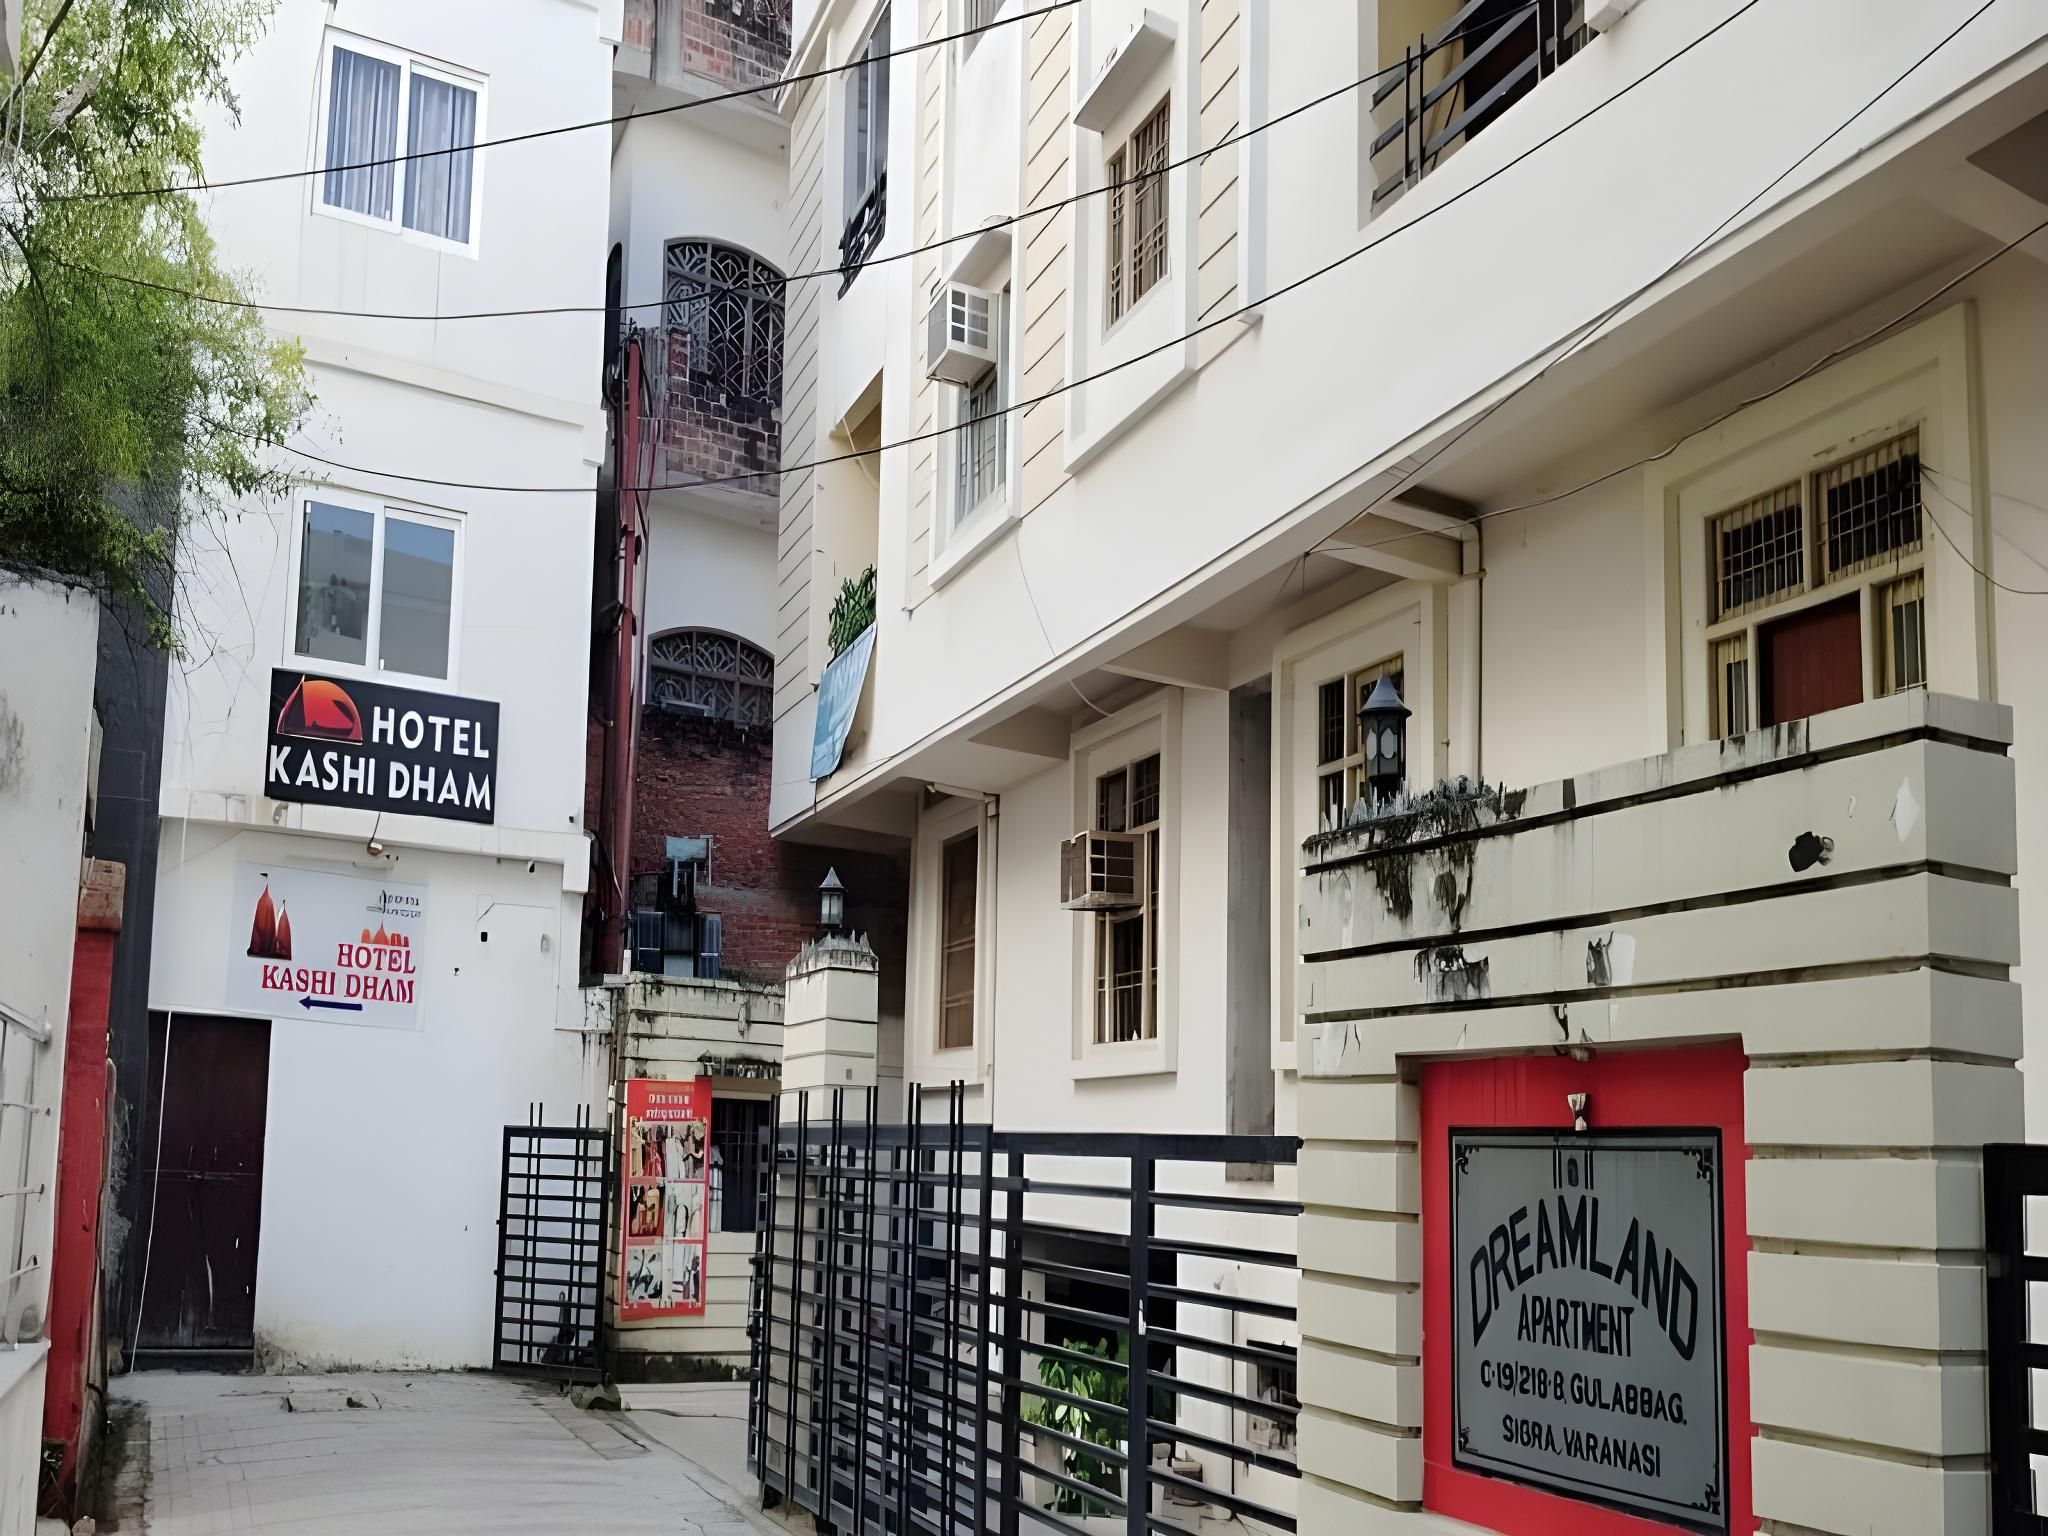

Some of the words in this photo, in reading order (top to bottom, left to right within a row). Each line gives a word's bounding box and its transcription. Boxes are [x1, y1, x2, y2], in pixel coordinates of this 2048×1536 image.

[372, 706, 489, 758] HOTEL
[268, 744, 376, 796] KASHI
[388, 761, 491, 811] DHAM
[261, 964, 336, 996] KASHI
[343, 974, 415, 1004] DHAM
[337, 943, 416, 974] HOTEL
[1470, 1194, 1698, 1362] DREAMLAND
[1517, 1293, 1634, 1357] APARTMENT
[1563, 1426, 1661, 1478] VARANASI
